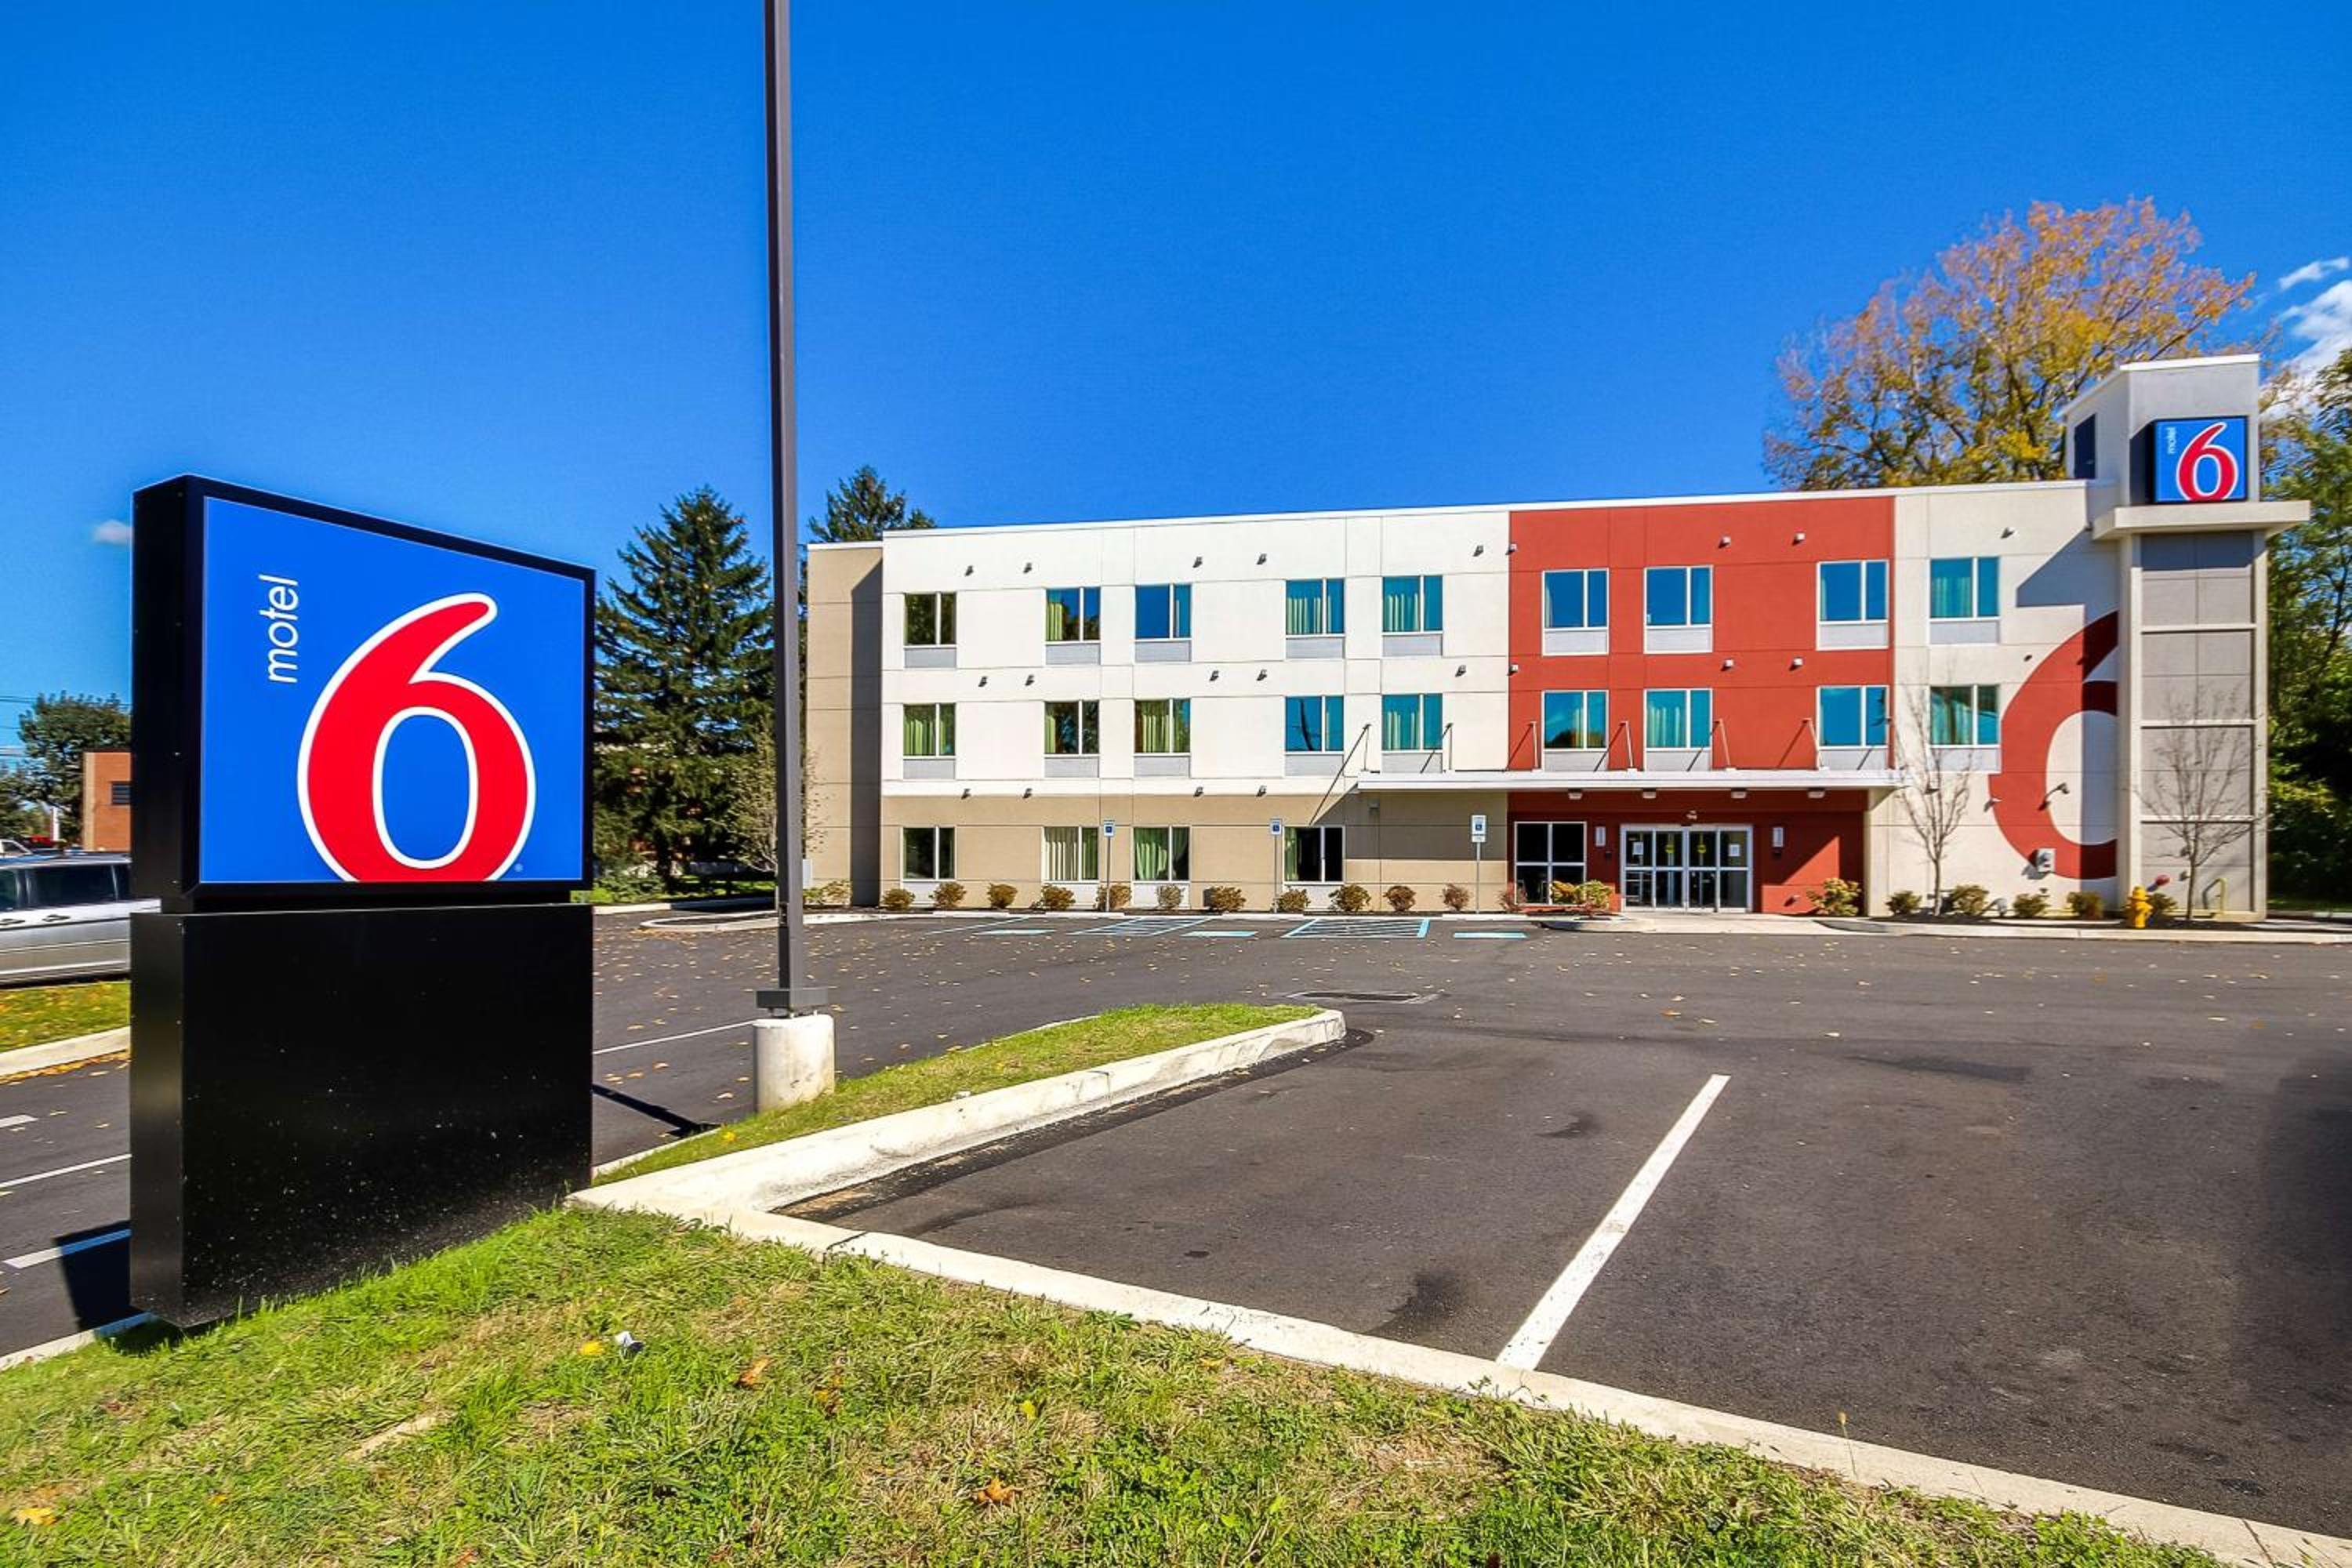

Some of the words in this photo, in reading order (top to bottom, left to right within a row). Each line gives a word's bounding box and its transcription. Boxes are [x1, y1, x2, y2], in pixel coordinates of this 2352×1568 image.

[2176, 422, 2239, 501] 6
[258, 574, 299, 683] motel
[297, 593, 536, 882] 6
